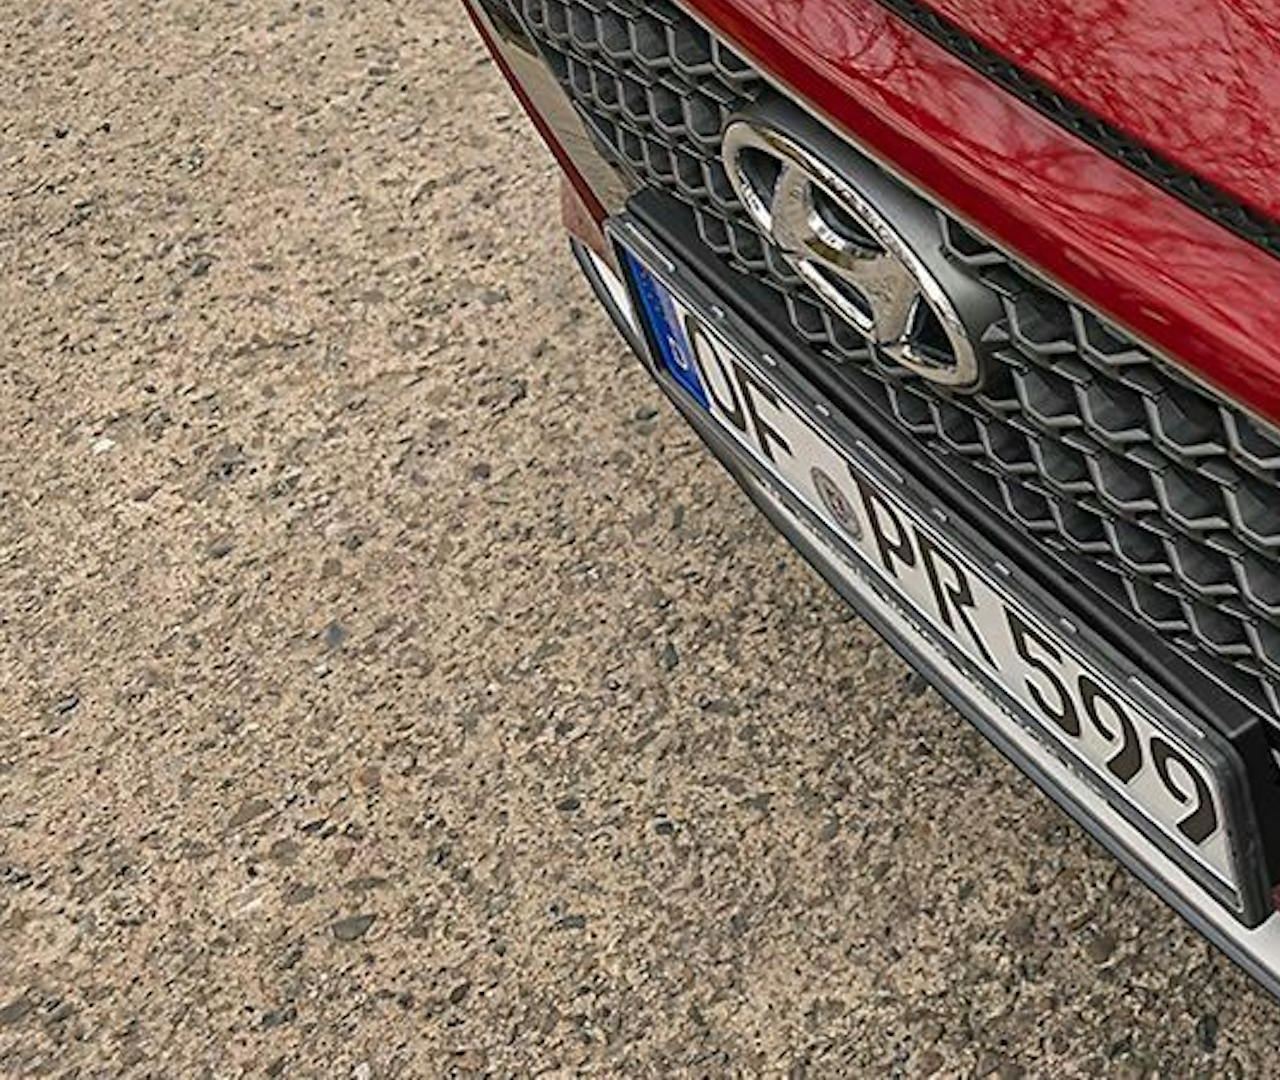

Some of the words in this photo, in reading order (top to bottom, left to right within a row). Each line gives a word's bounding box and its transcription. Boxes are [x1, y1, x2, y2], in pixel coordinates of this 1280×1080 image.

[686, 315, 793, 462] OF
[848, 463, 1000, 671] PR
[1003, 605, 1217, 845] 599
